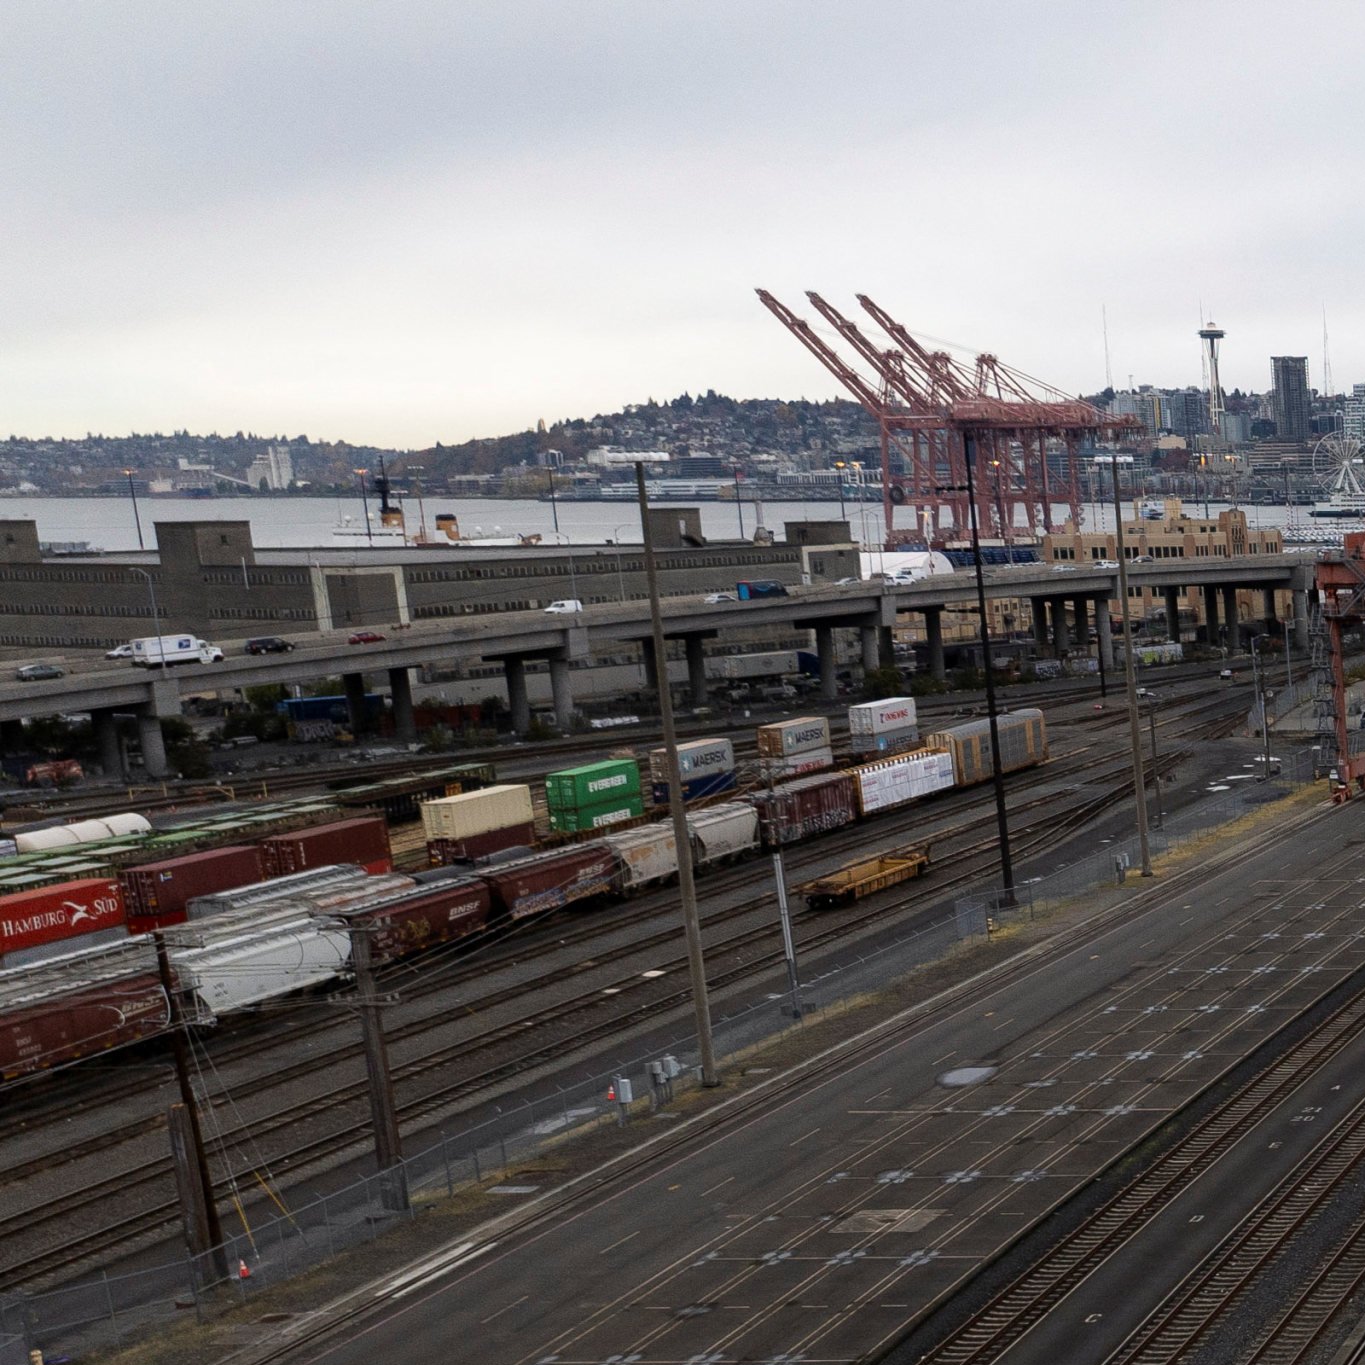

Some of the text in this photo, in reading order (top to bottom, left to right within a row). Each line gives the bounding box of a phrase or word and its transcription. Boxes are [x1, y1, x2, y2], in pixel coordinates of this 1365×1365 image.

[795, 726, 824, 744] MAERSK
[692, 749, 727, 768] MAERSK
[588, 775, 627, 793] EVERGREEN
[3, 896, 118, 937] HAMBURG SÜD
[449, 900, 482, 919] BNSF
[1188, 1214, 1205, 1223] D
[1084, 1313, 1103, 1323] C
